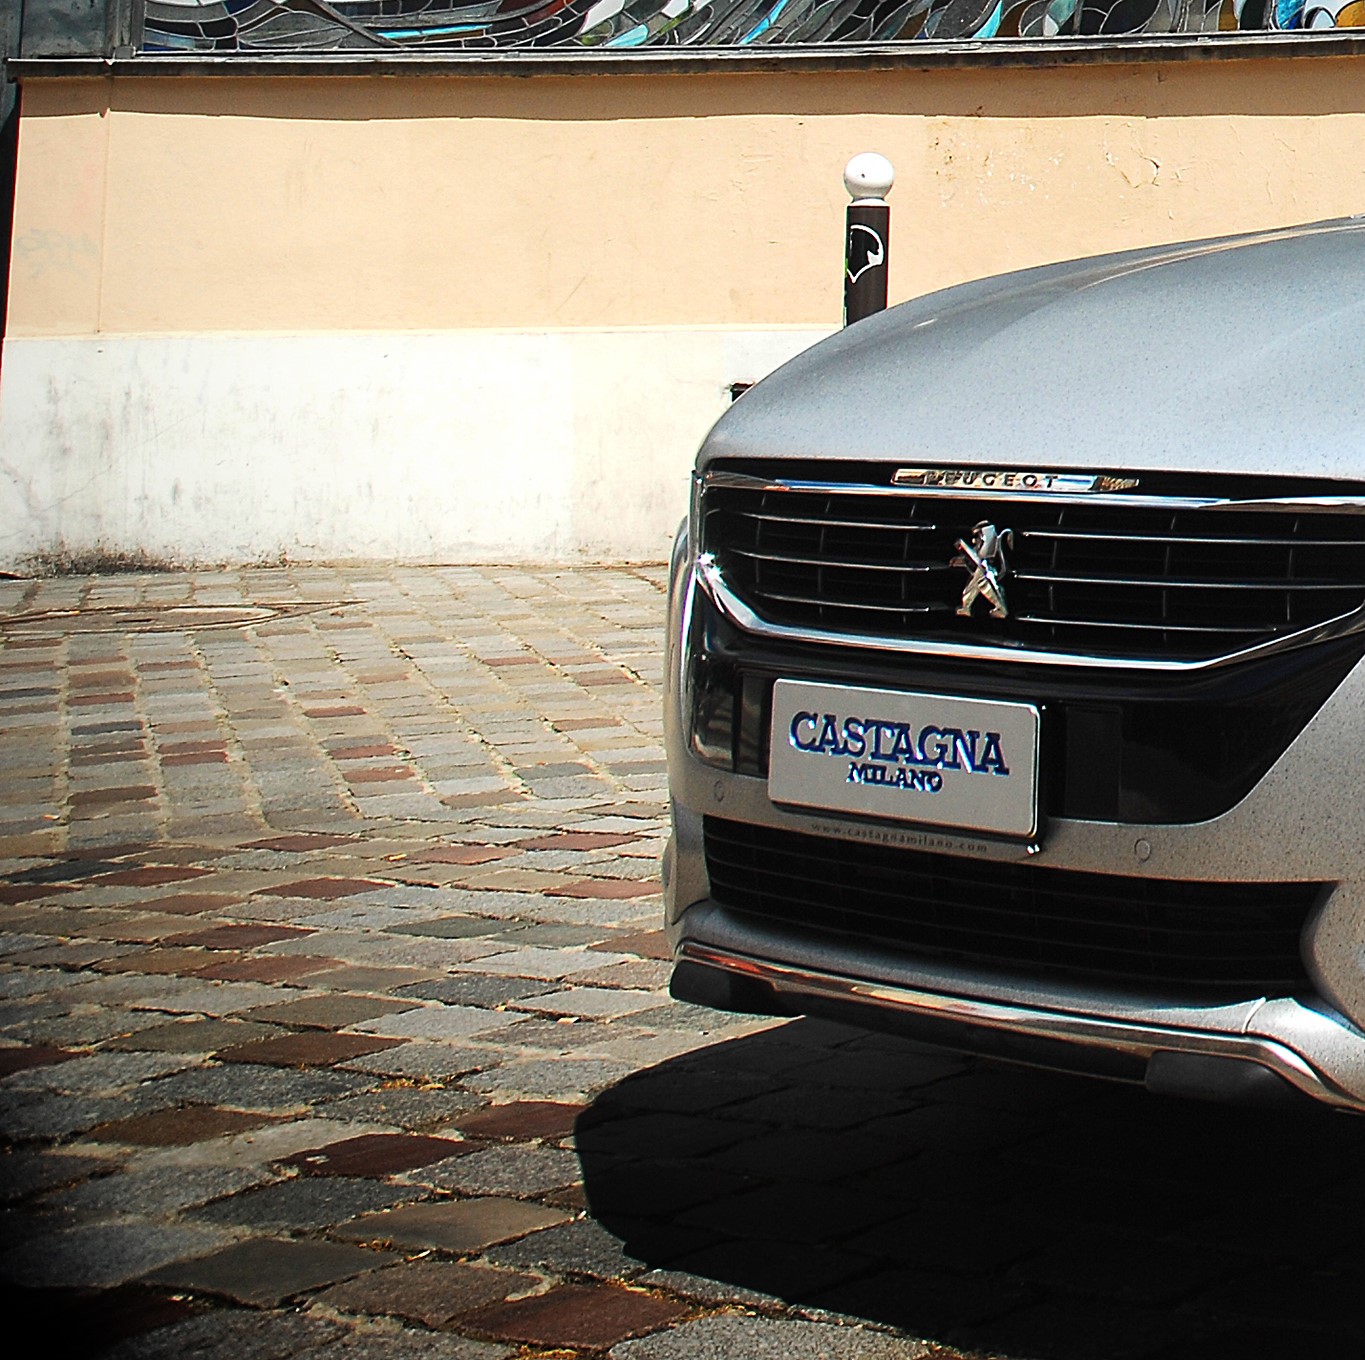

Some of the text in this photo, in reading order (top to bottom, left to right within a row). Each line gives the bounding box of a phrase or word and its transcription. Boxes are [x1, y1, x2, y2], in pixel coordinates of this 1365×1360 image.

[926, 470, 1060, 489] PEUGEOT
[789, 711, 1010, 776] CASTAGNA
[846, 762, 944, 793] MILANO
